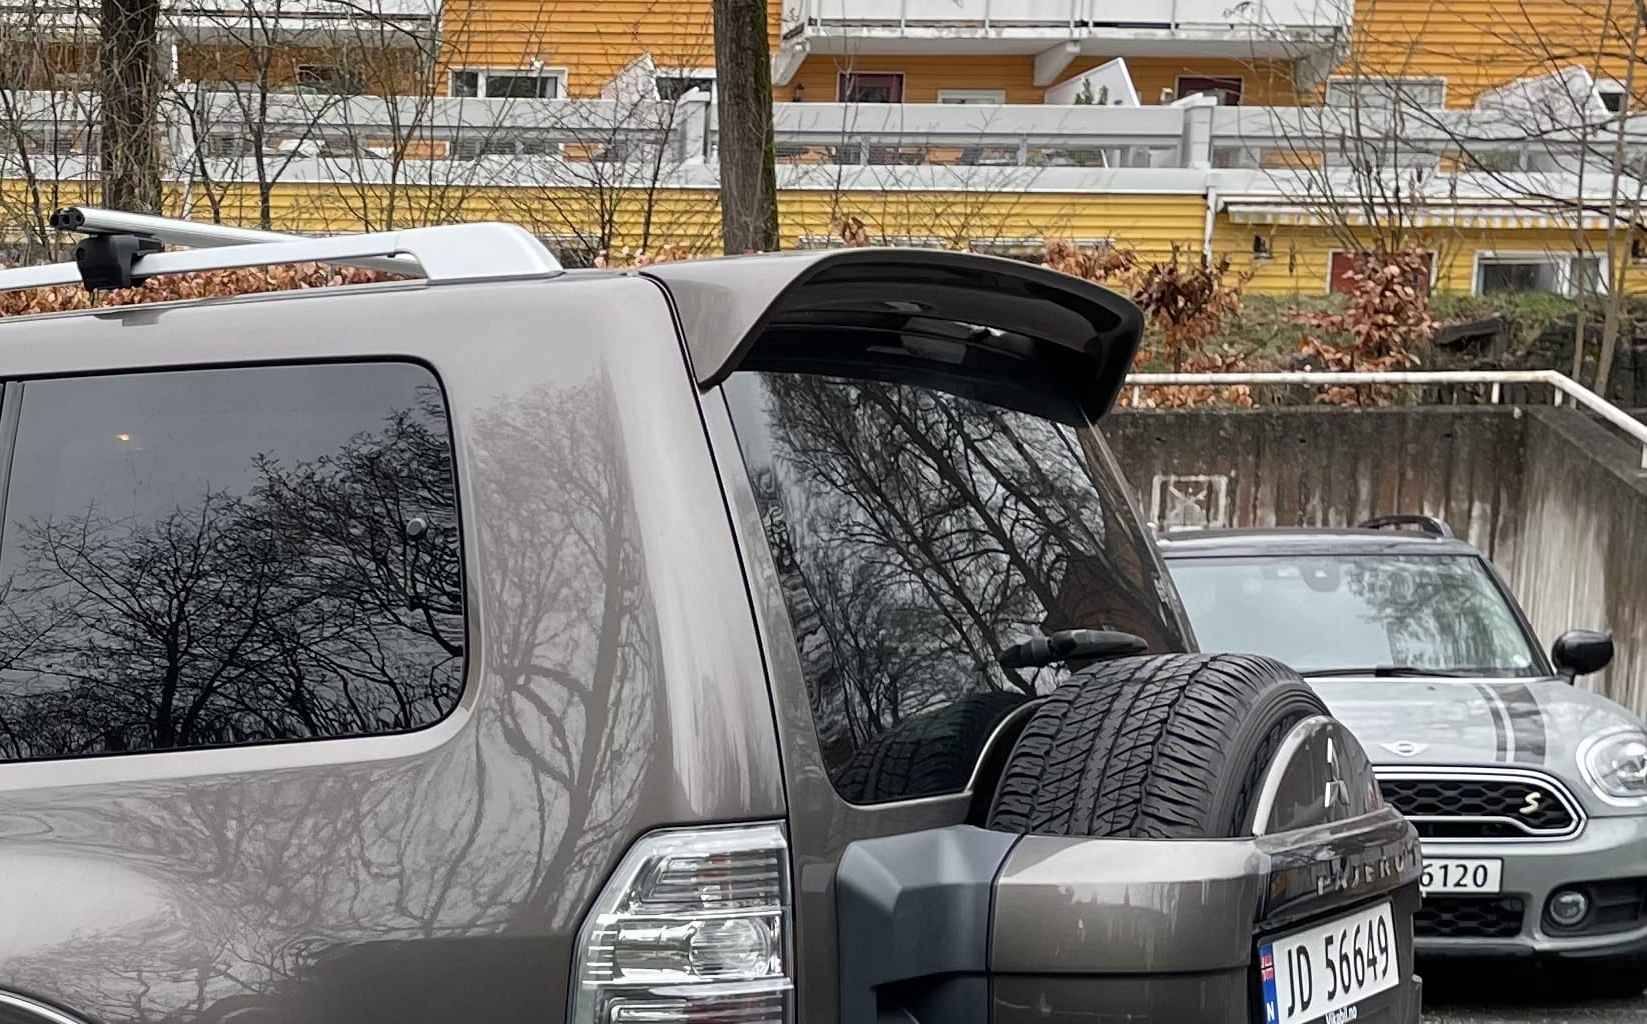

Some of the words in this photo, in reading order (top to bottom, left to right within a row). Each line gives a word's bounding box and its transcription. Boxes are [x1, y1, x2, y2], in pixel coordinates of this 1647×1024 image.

[1519, 791, 1541, 814] S
[1420, 863, 1488, 888] 6120
[1287, 945, 1313, 1018] JD
[1323, 915, 1389, 1000] 56649
[1266, 1001, 1275, 1022] N
